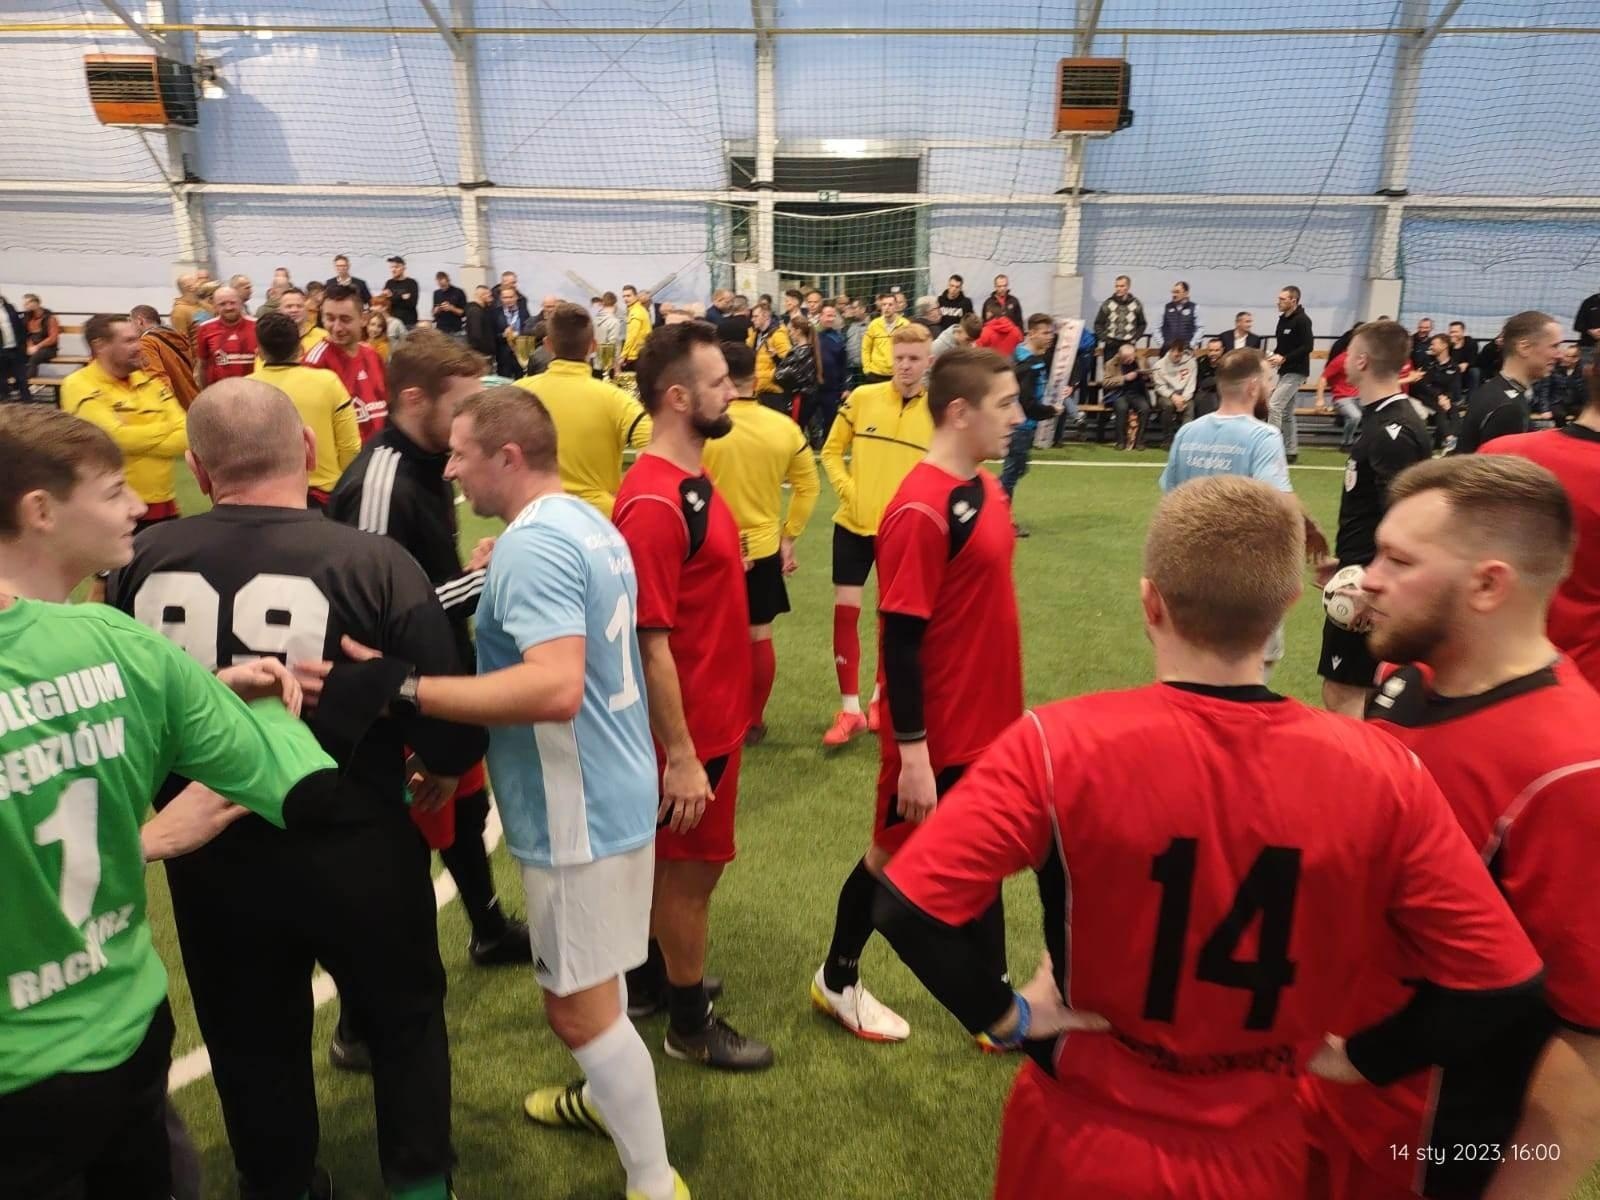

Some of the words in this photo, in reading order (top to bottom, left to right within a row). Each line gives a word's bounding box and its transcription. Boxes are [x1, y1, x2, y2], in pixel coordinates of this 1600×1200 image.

[605, 592, 640, 713] 1
[34, 777, 101, 929] 1
[1141, 836, 1304, 1032] 14
